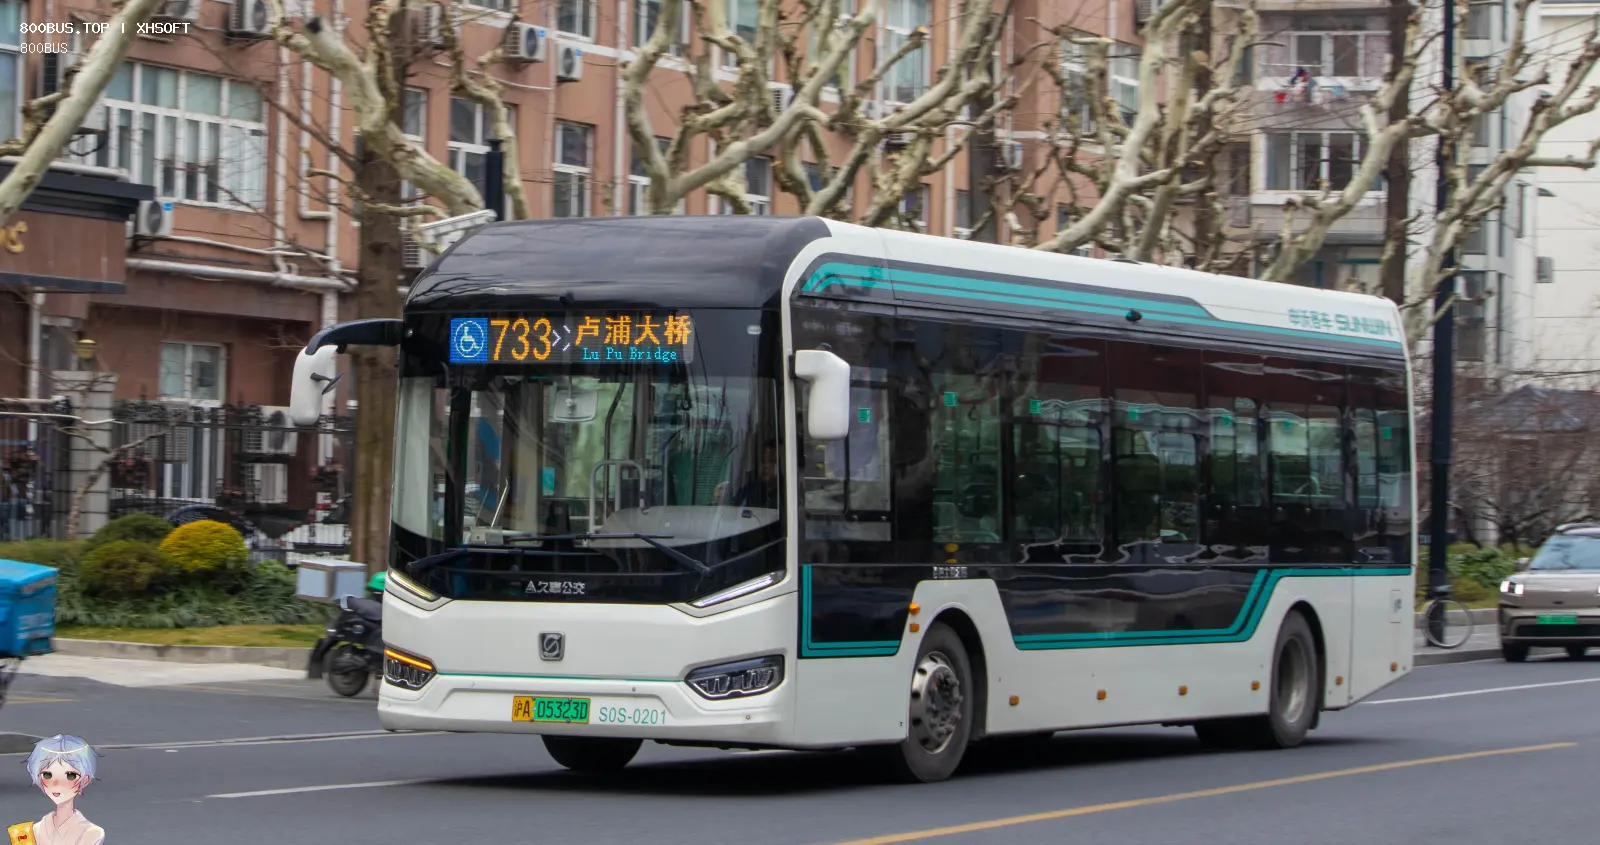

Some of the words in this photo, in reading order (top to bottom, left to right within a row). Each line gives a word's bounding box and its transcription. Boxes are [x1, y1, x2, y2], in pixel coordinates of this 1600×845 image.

[491, 318, 552, 361] 733
[575, 315, 692, 345] 卢浦大桥
[583, 347, 599, 360] Lu
[606, 347, 622, 360] Pu
[629, 346, 677, 362] Bridge
